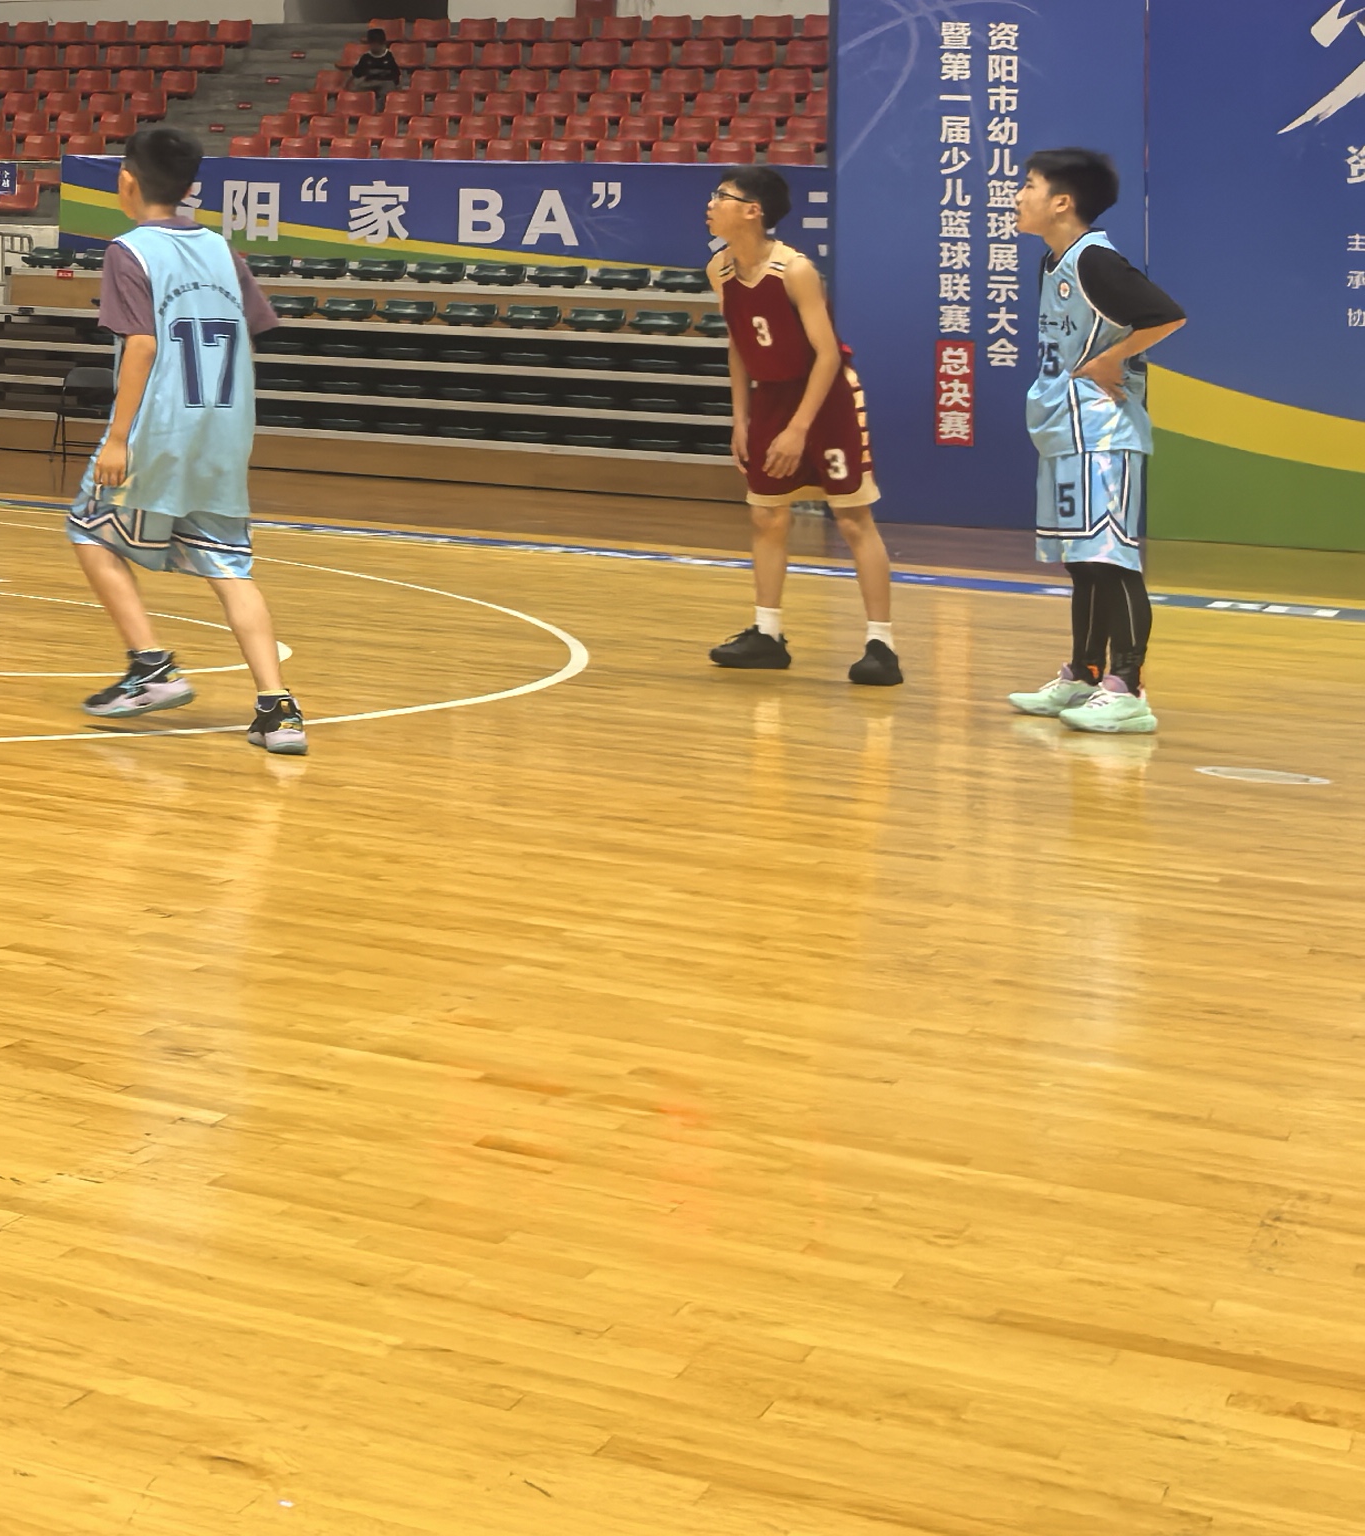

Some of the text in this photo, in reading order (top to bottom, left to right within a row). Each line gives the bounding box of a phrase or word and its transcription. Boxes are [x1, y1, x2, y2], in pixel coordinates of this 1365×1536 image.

[986, 21, 1019, 368] 资阳市幼儿篮球展示大会
[938, 21, 972, 442] 暨第一届少儿篮球联赛 总决赛
[752, 316, 773, 347] 3
[168, 318, 240, 408] 17
[823, 448, 849, 480] 3
[1057, 482, 1075, 517] 5
